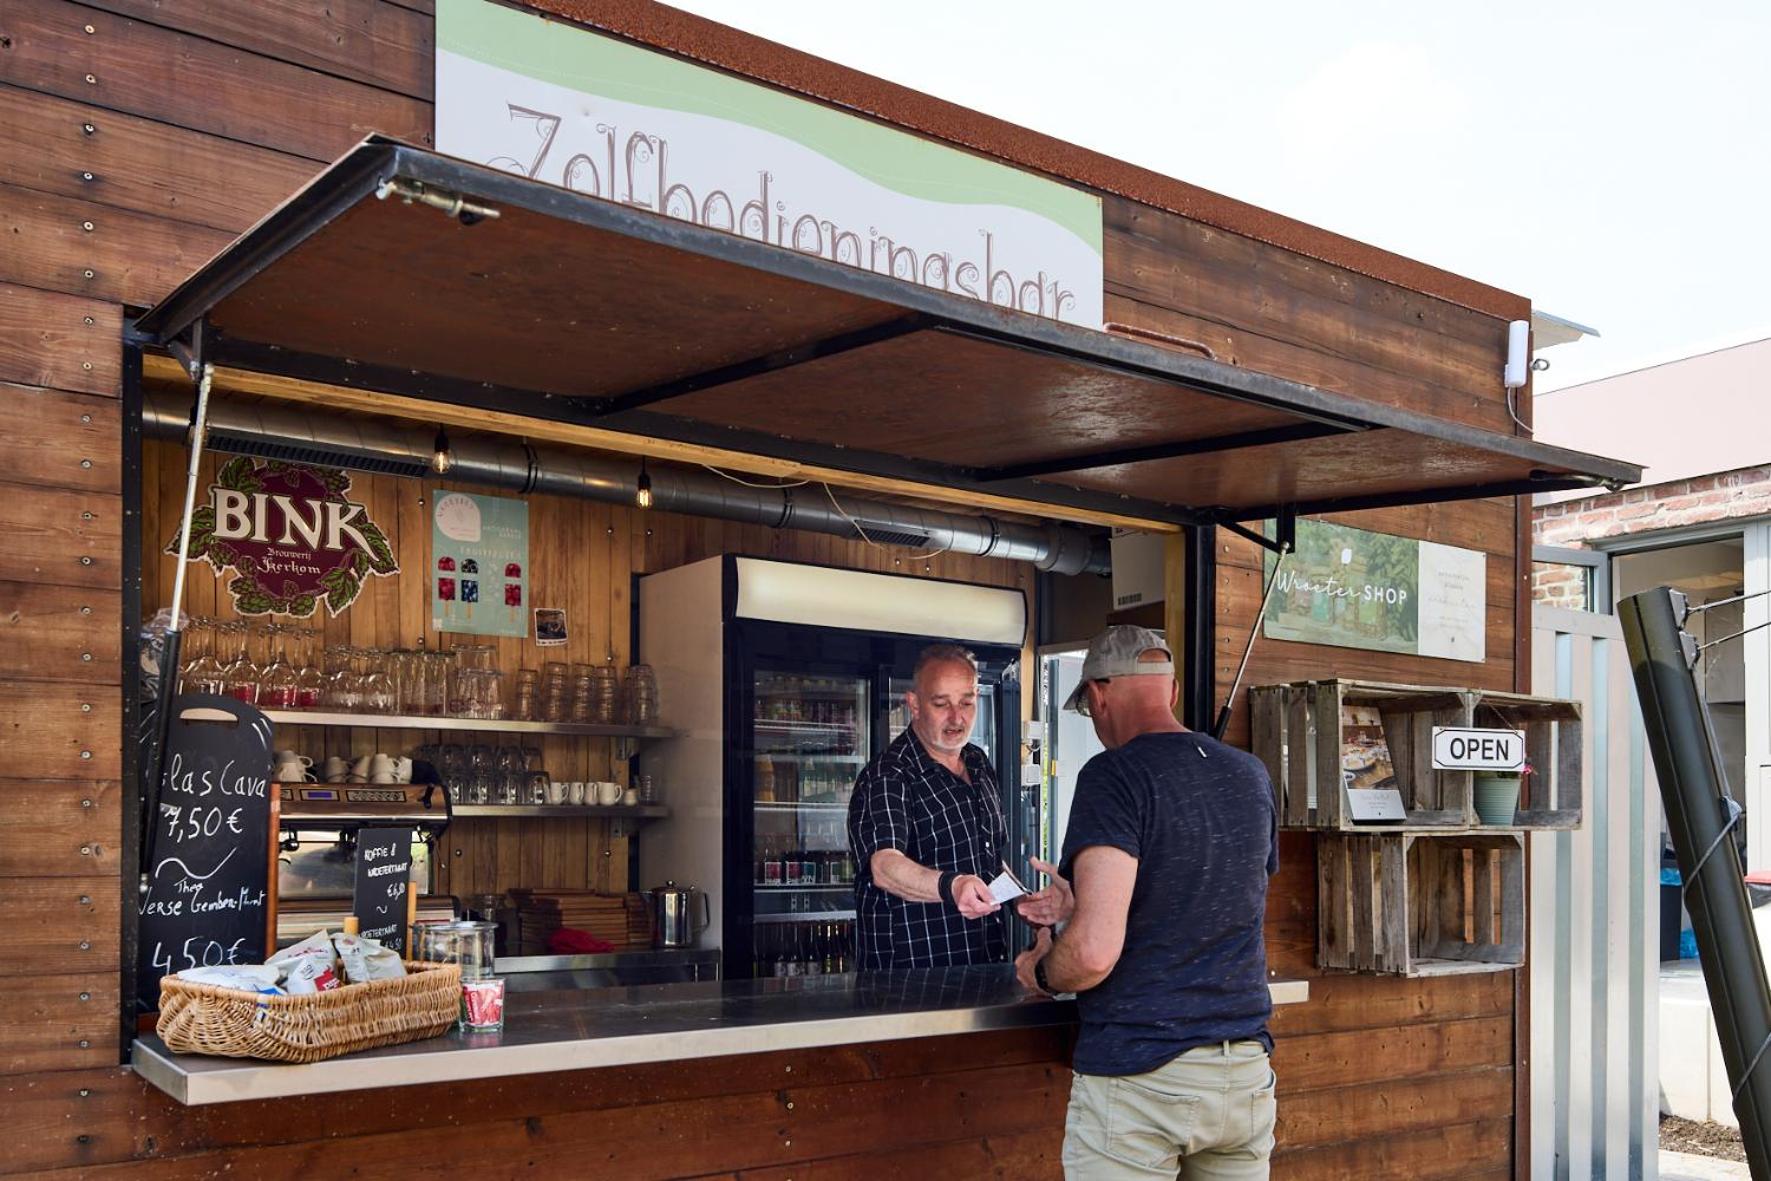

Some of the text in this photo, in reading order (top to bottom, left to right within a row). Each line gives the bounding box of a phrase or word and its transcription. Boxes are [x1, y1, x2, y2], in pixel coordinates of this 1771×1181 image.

[211, 488, 380, 562] BINK
[256, 556, 322, 576] Kerkom
[266, 546, 312, 561] Brouwerij
[1275, 566, 1361, 597] Wroeter
[1364, 584, 1408, 605] SHOP
[1449, 737, 1510, 762] OPEN
[161, 753, 267, 798] las Cava
